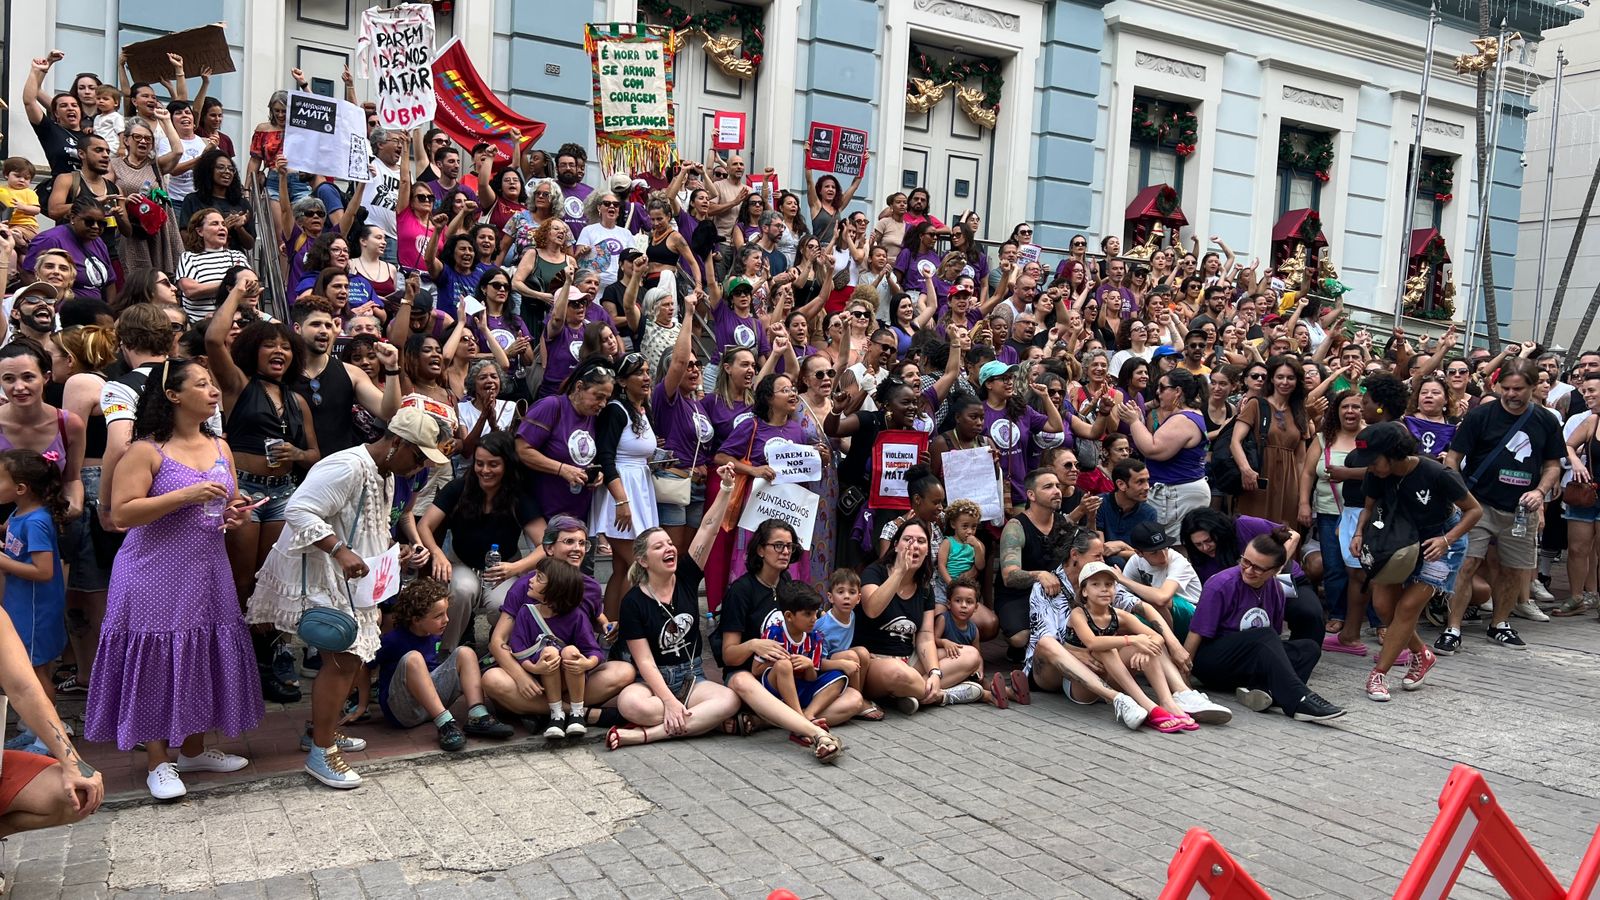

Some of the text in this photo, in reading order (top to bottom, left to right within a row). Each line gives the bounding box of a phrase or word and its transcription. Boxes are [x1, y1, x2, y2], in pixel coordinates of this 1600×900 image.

[376, 23, 423, 48] PAREM
[379, 46, 428, 69] DE NOS
[601, 44, 659, 60] É HORA DE
[602, 65, 656, 77] SE ARMAR
[623, 78, 644, 90] COM
[609, 92, 657, 104] CORAGEM
[298, 107, 329, 121] MATA
[630, 103, 638, 114] E
[383, 104, 426, 126] UBM
[604, 115, 667, 128] ESPERANÇA
[837, 153, 858, 165] BASTA
[775, 452, 802, 460] PAREM
[885, 451, 914, 460] VIOLÊNCIA
[781, 467, 812, 476] MATAR!
[757, 504, 802, 528] MAISFORTES
